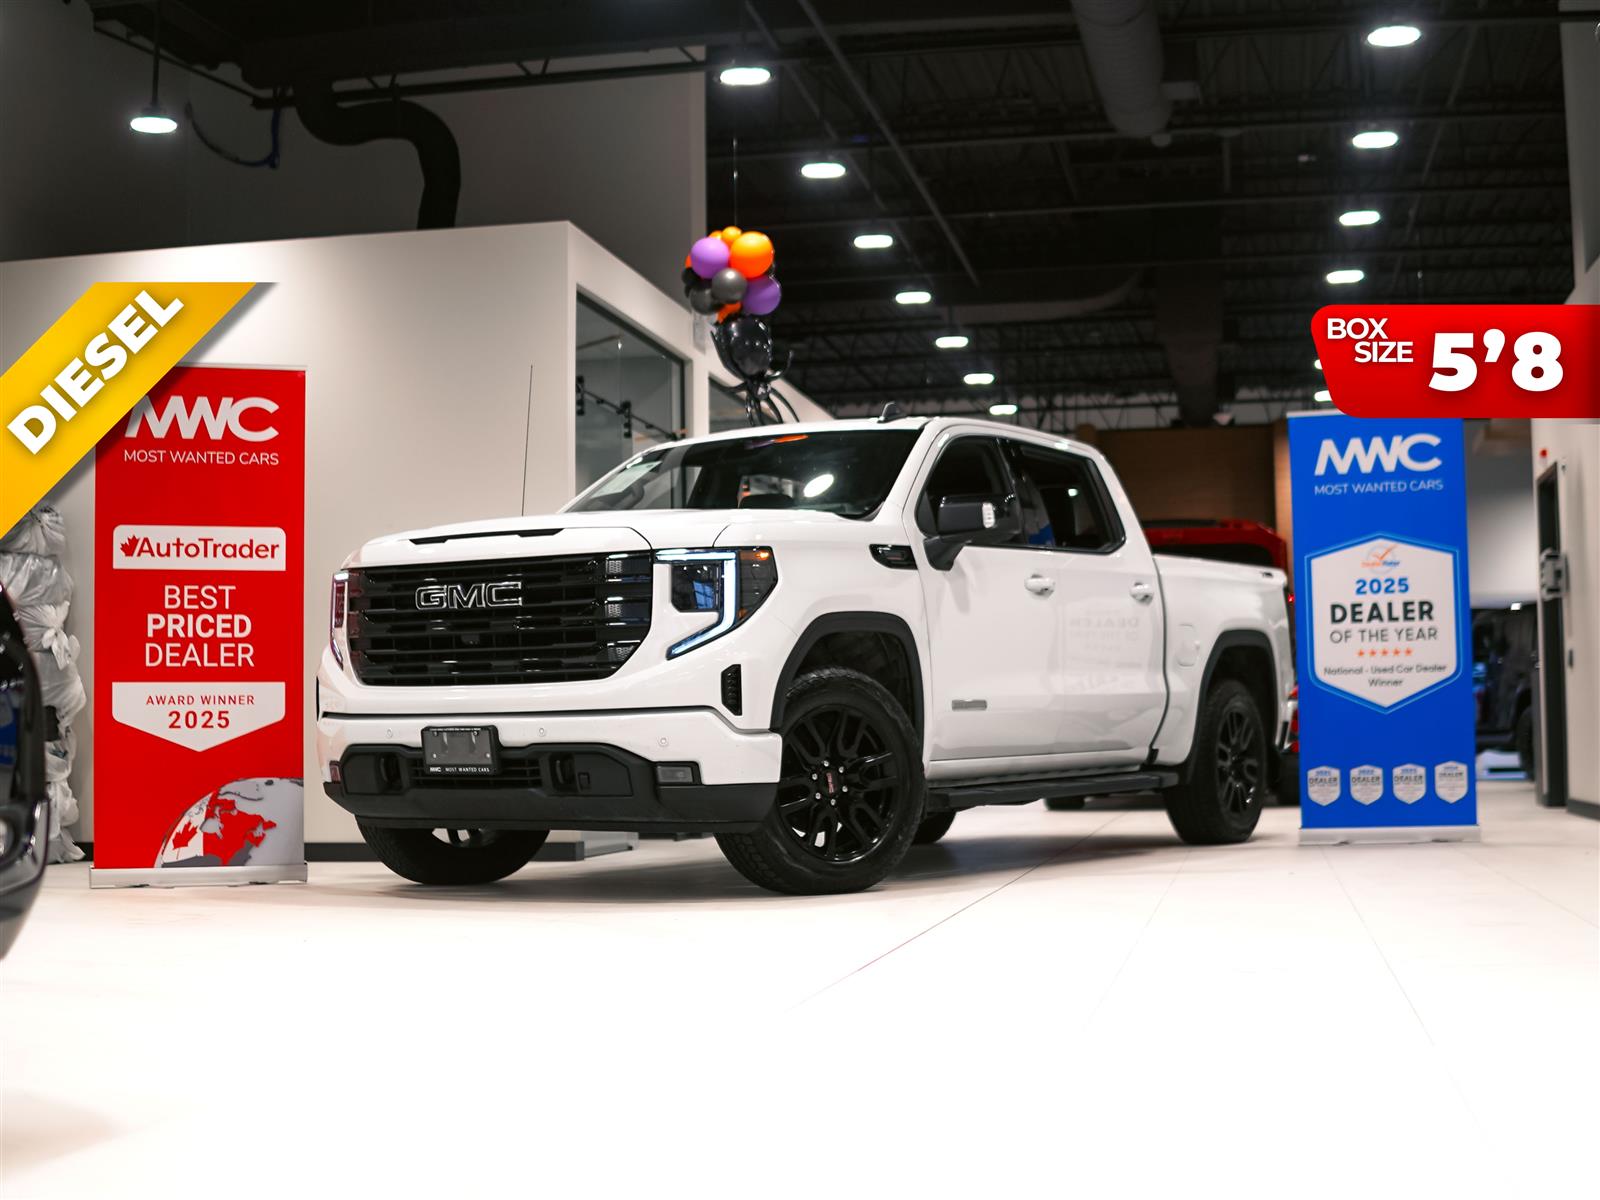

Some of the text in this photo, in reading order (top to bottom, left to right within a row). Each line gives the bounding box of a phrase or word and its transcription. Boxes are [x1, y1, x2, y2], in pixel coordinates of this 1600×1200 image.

[125, 395, 280, 442] MWC
[124, 450, 279, 466] MOST WANTED CARS
[1314, 433, 1442, 476] MWC
[1314, 479, 1444, 496] MOST WANTED CARS
[137, 537, 279, 559] AutoTrader
[415, 582, 522, 610] GMC
[1355, 577, 1409, 595] 2025
[164, 585, 236, 609] BEST
[1330, 601, 1434, 624] DEALER
[147, 613, 252, 638] PRICED
[1329, 627, 1438, 644] OF THE YEAR
[145, 643, 255, 667] DEALER
[1324, 666, 1363, 676] National
[1370, 665, 1394, 675] Used
[1416, 663, 1447, 673] Dealer
[1368, 678, 1403, 688] Winner
[146, 695, 255, 705] AWARD WINNER
[168, 710, 230, 729] 2025
